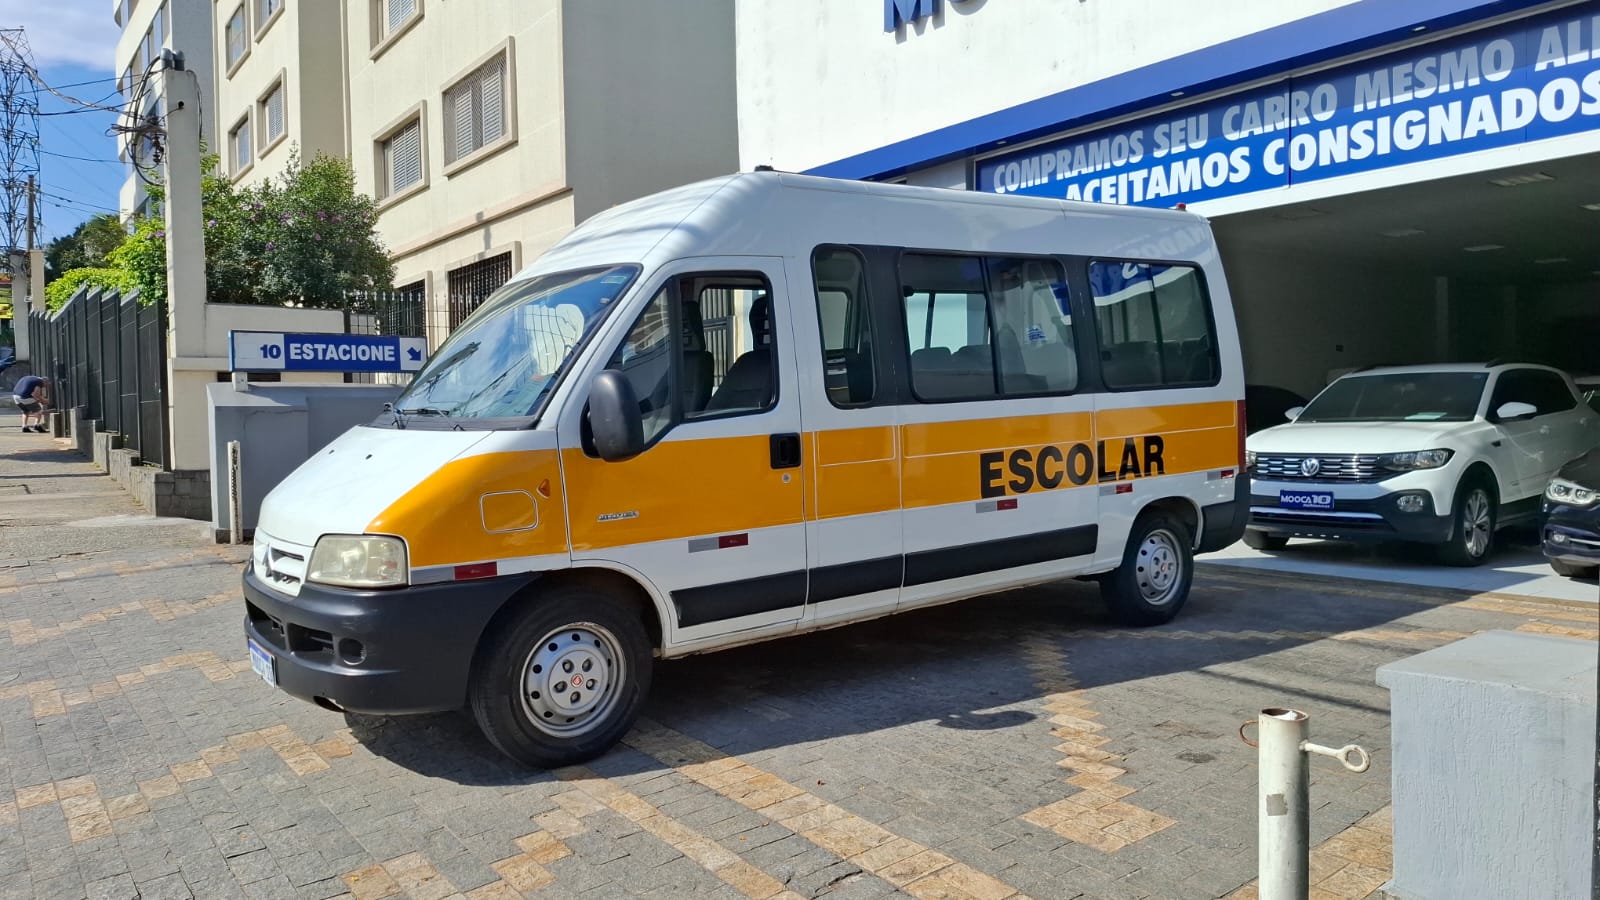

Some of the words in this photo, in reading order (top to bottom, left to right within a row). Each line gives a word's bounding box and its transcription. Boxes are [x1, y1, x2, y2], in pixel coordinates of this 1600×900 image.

[993, 129, 1144, 194] COMPRAMOS
[1152, 111, 1208, 158] SEU
[1221, 83, 1338, 141] CARRO
[1353, 38, 1515, 113] MESMO
[1066, 146, 1251, 205] ACEITAMOS
[1263, 69, 1600, 175] CONSIGNADOS
[260, 344, 282, 359] 10
[290, 343, 396, 361] ESTACIONE
[980, 435, 1165, 500] ESCOLAR
